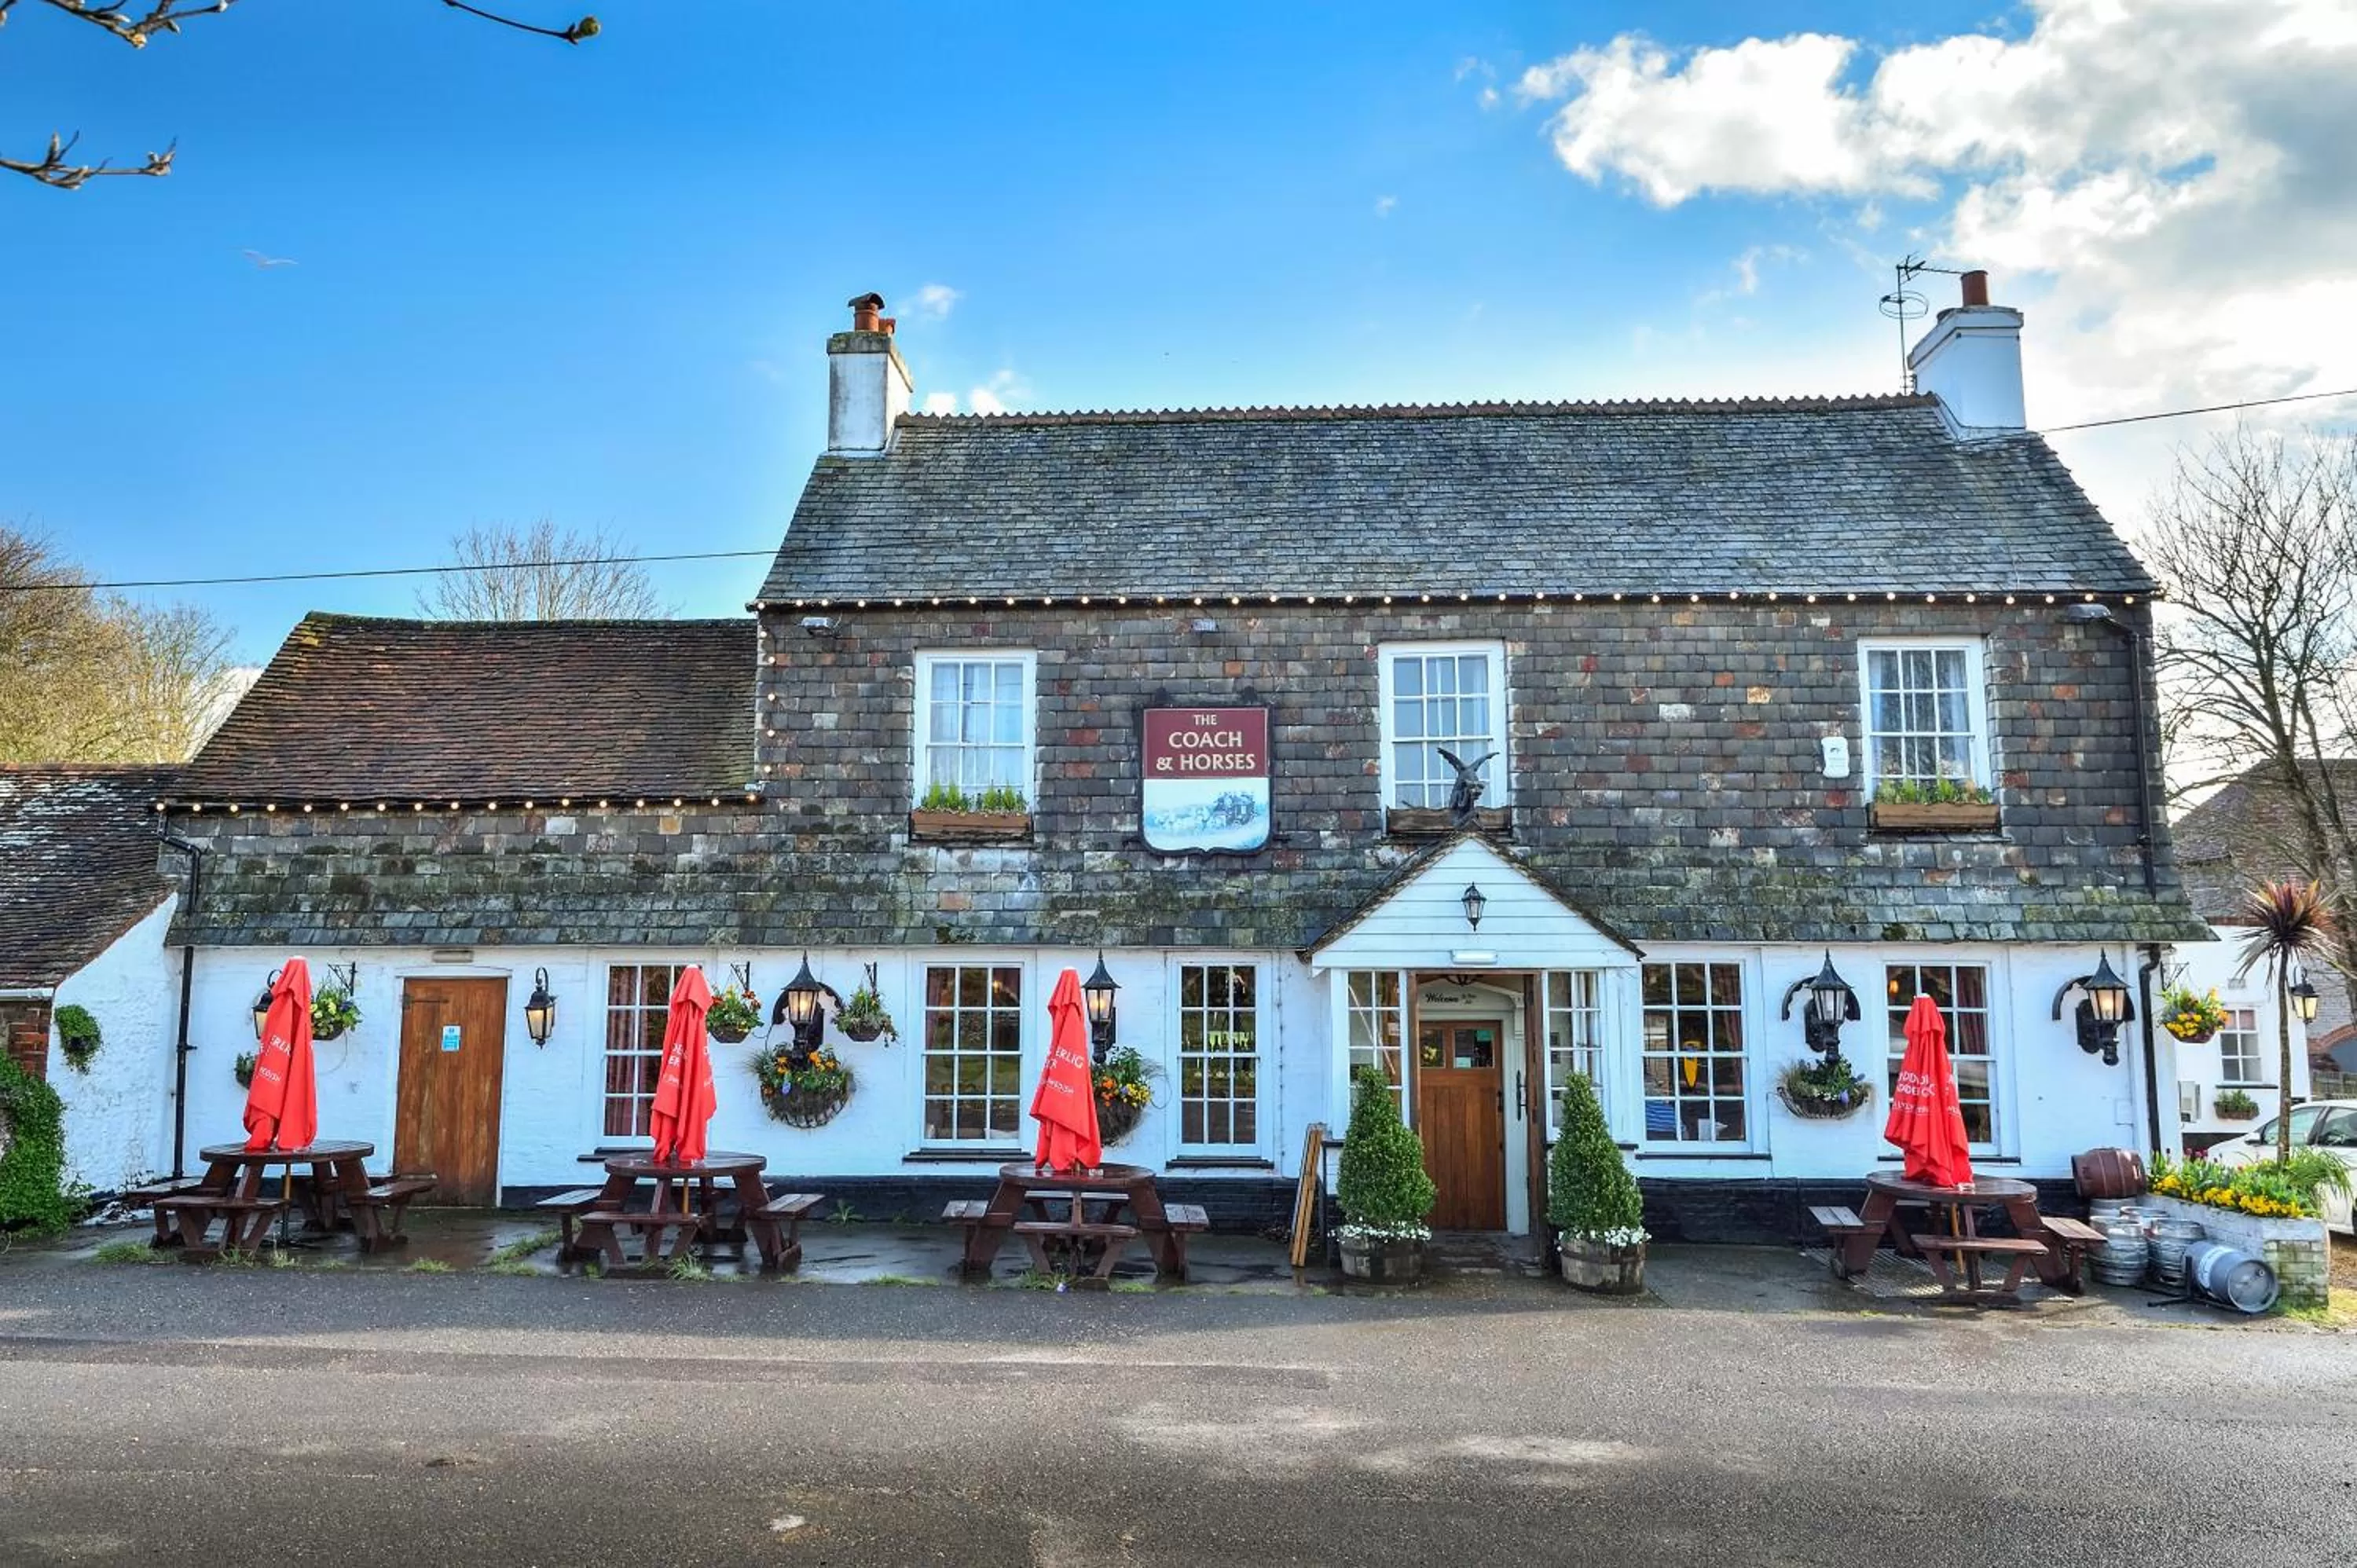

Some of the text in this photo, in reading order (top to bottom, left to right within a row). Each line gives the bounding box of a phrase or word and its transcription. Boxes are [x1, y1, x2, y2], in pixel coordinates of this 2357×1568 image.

[1193, 714, 1218, 726] THE
[1168, 731, 1242, 749] COACH
[1156, 753, 1255, 771] & HORSES
